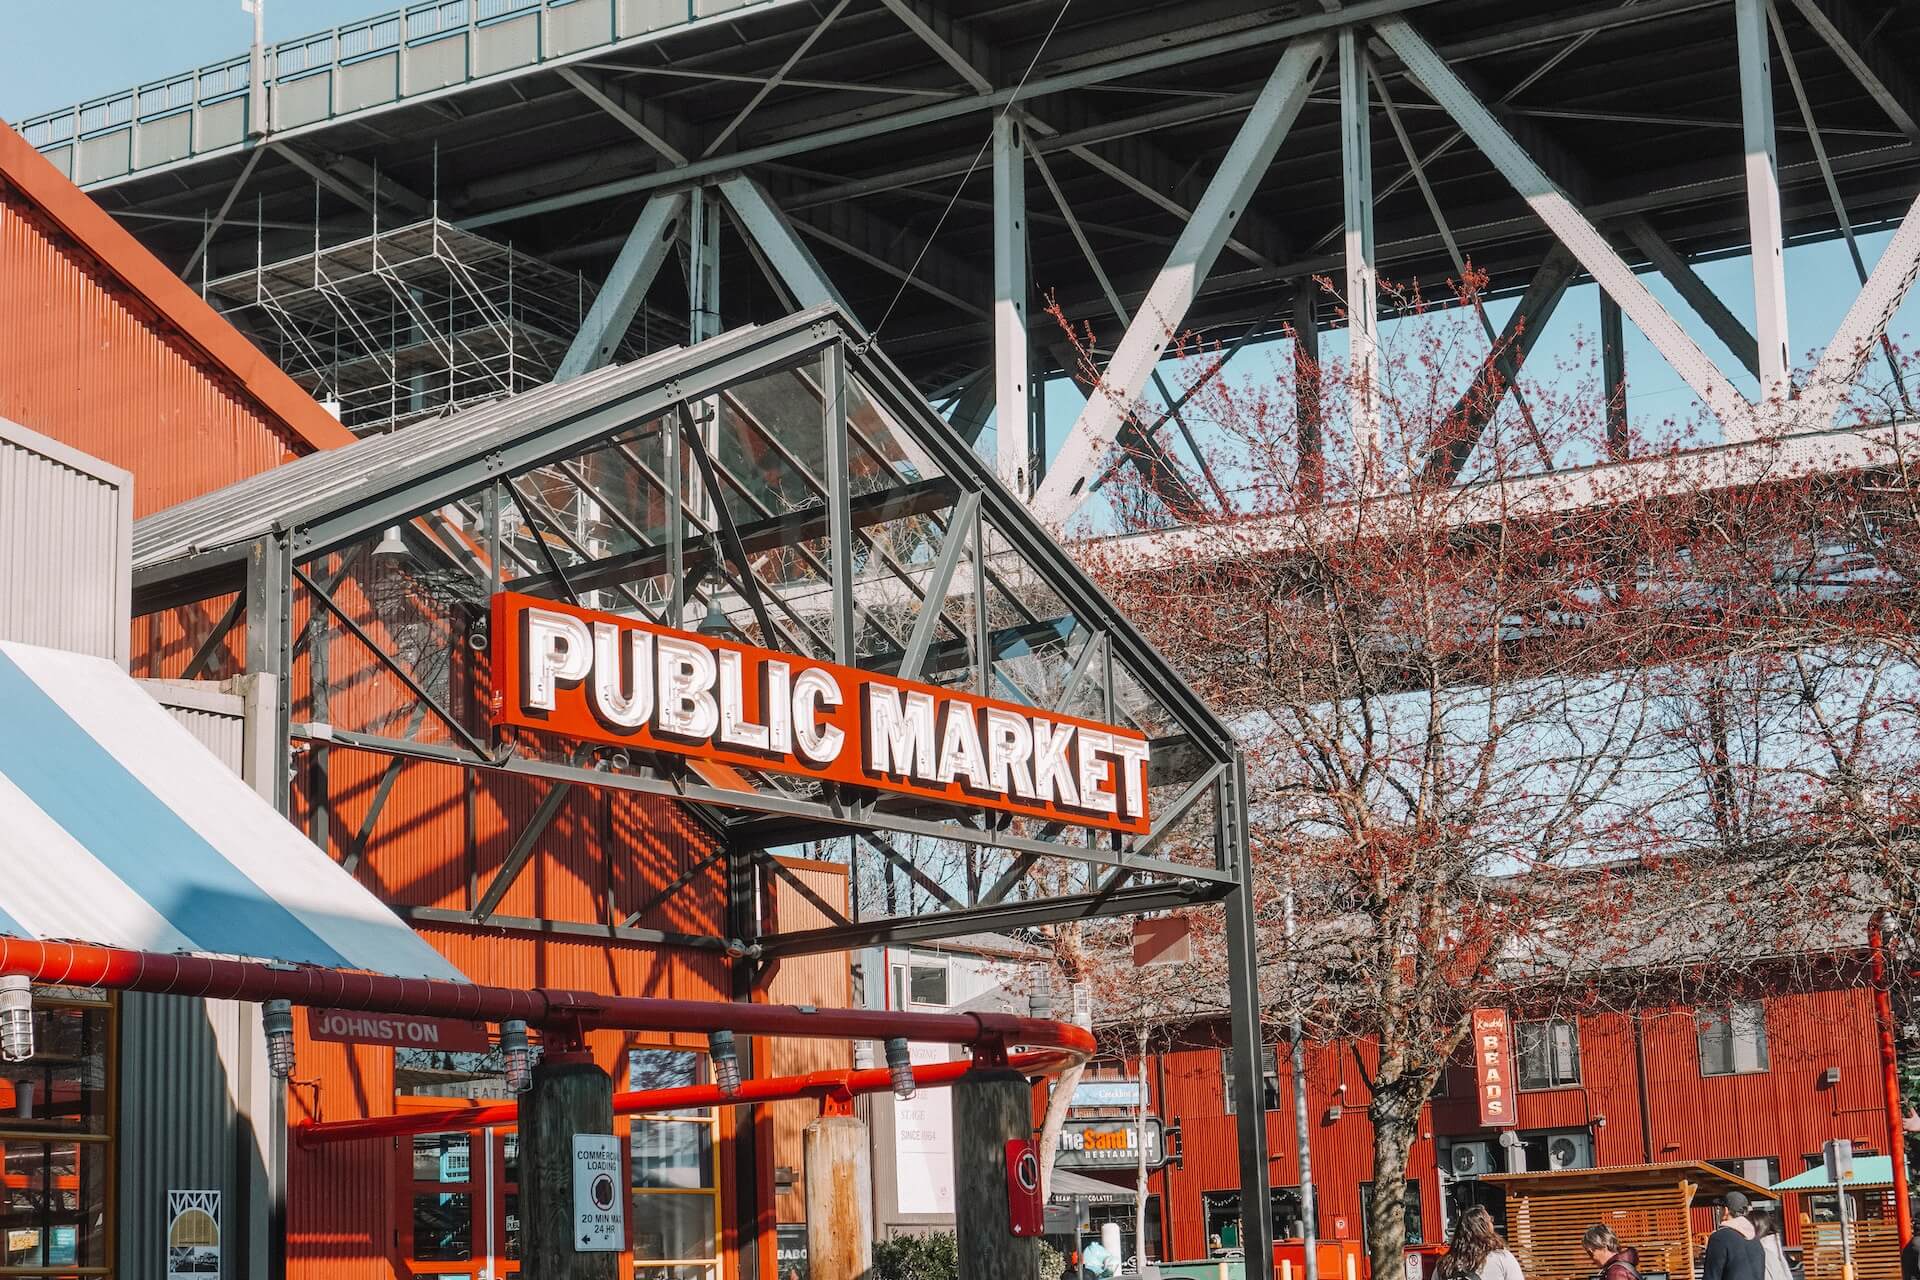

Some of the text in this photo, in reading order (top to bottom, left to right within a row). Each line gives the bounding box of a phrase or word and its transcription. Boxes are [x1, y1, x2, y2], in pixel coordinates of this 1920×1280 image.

[522, 607, 1149, 819] PUBLIC MARKET
[319, 1015, 439, 1043] JOHNSTON
[1483, 1036, 1503, 1115] BEADS
[587, 1161, 616, 1171] LOADING
[581, 1214, 593, 1224] 20
[595, 1214, 609, 1224] MIN
[594, 1225, 616, 1234] 24 HR
